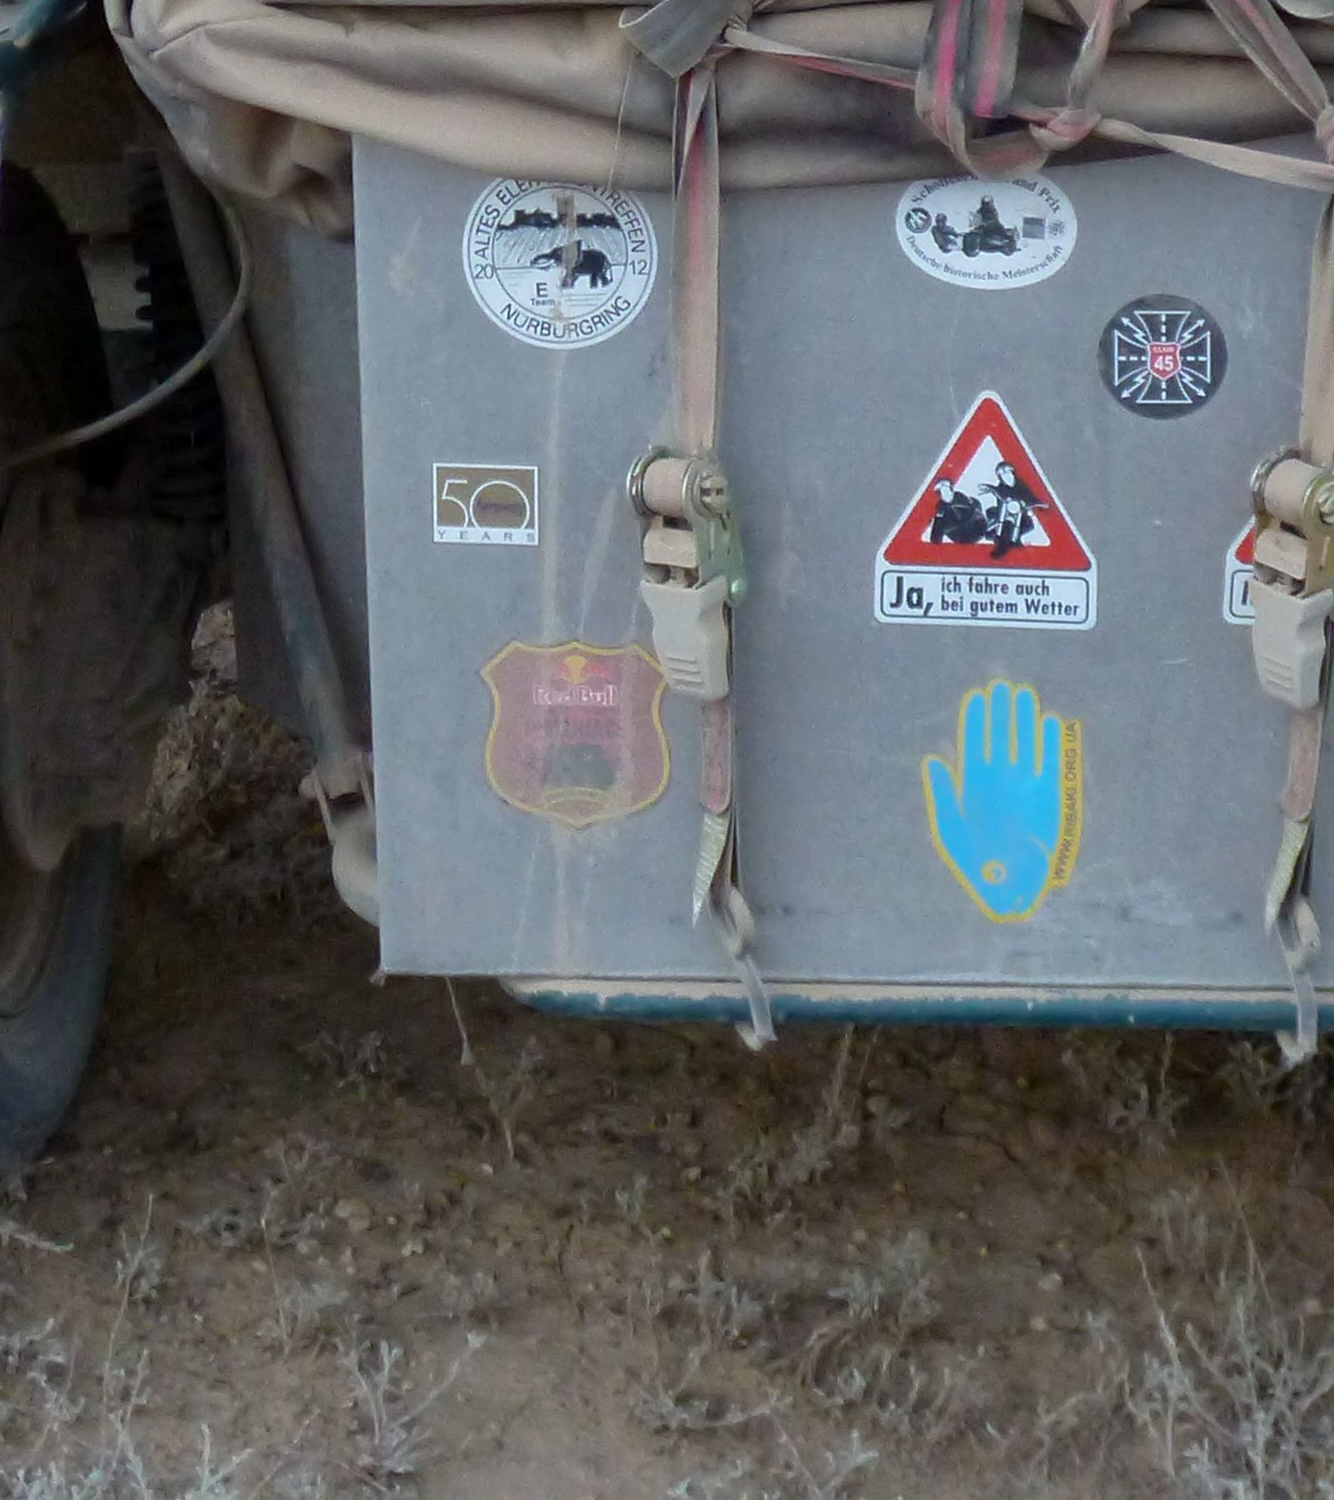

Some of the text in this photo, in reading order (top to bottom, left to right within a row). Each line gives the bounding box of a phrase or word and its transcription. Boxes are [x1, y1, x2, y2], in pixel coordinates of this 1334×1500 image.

[1038, 184, 1061, 214] Prix
[474, 208, 501, 259] ALTES
[473, 260, 649, 280] 20 12
[943, 263, 1000, 281] historische
[1001, 244, 1064, 281] Meisterschaft
[535, 282, 548, 298] E
[1153, 355, 1175, 372] 45
[441, 478, 531, 529] 50
[437, 530, 536, 542] YEARS
[889, 575, 1050, 616] Ja, ich fahre auch
[940, 596, 1080, 618] bei gutem Wetter
